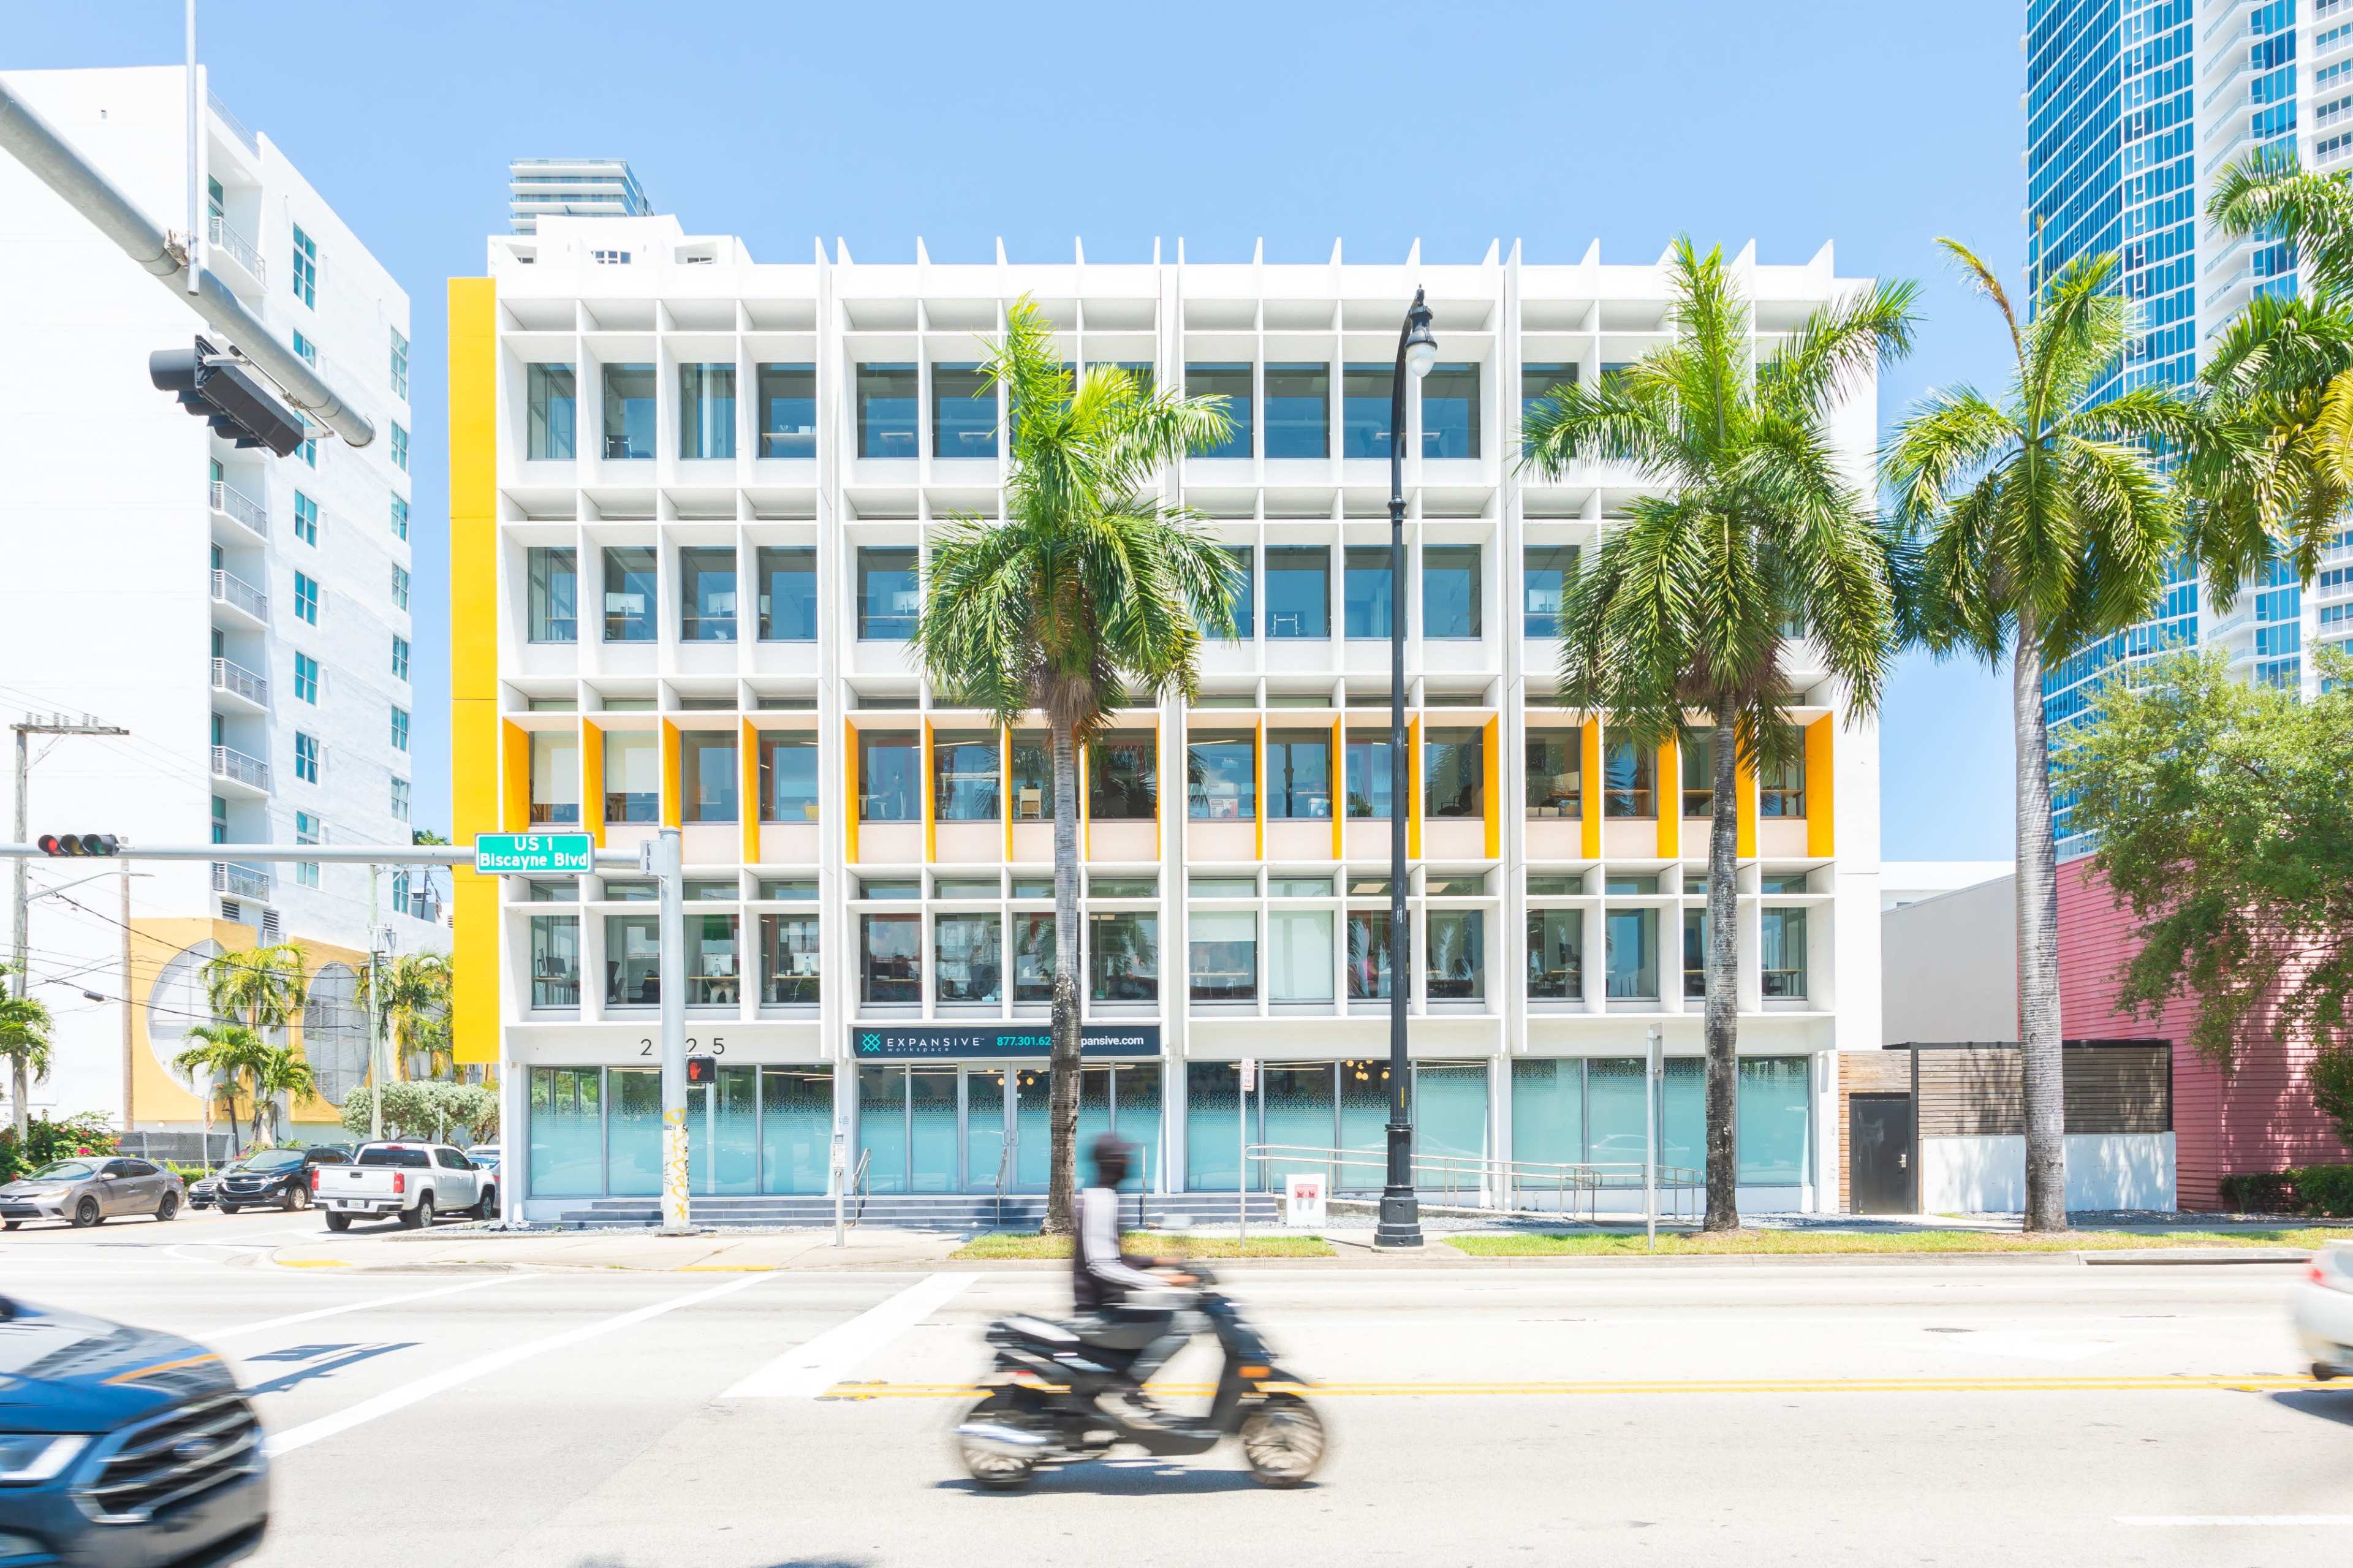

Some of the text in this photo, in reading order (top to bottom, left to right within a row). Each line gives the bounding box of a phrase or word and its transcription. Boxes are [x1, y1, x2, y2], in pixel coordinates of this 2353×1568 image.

[514, 836, 554, 851] US 1
[480, 852, 587, 870] Biscayne Blvd
[640, 1038, 725, 1055] 225
[887, 1037, 980, 1047] EXPANSIVE
[997, 1036, 1144, 1048] 877.301.62 pansive.com
